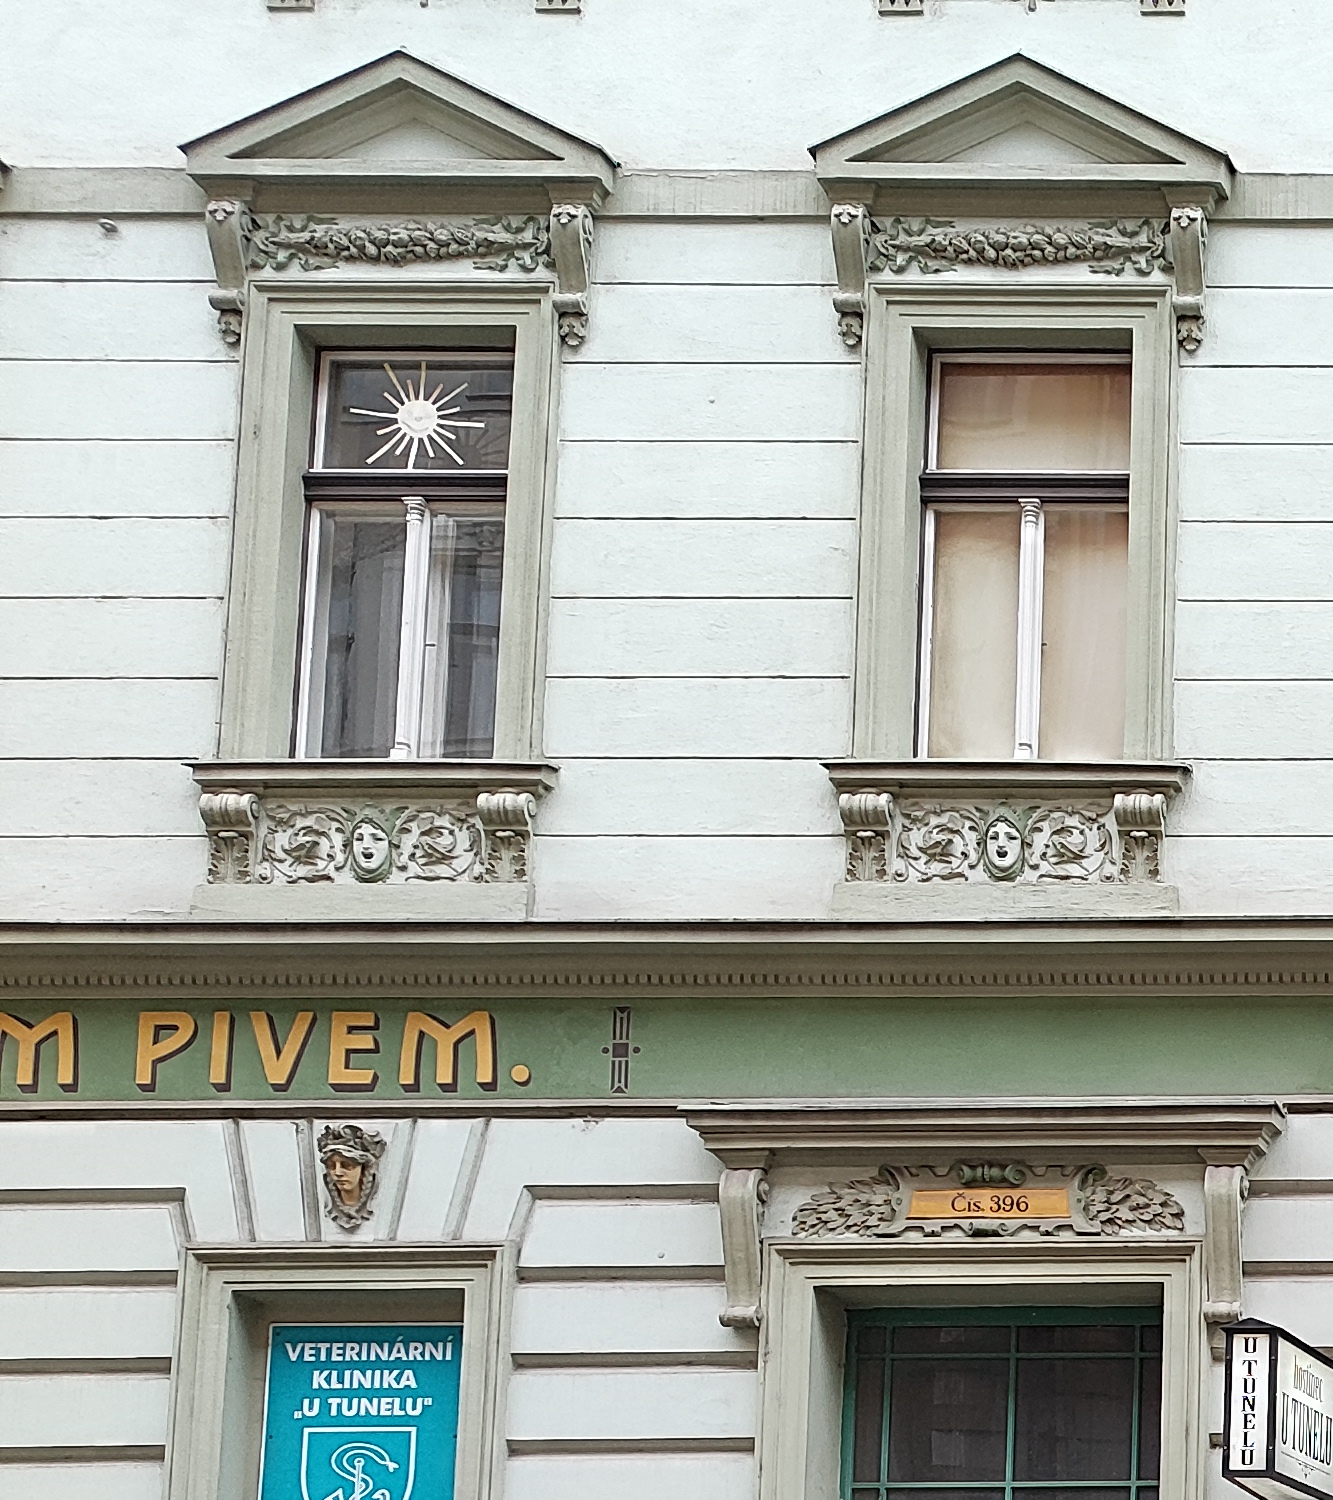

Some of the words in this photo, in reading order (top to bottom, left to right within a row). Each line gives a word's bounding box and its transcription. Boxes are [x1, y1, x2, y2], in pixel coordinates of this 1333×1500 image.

[136, 1010, 531, 1092] PIVEM.
[989, 1195, 1029, 1213] 396
[285, 1336, 454, 1362] VETERINÁRNÍ
[1243, 1337, 1258, 1353] U
[312, 1369, 418, 1390] KLINIKA
[1240, 1360, 1258, 1466] TUNELU
[1281, 1391, 1290, 1445] U
[1291, 1397, 1333, 1466] TUNELU
